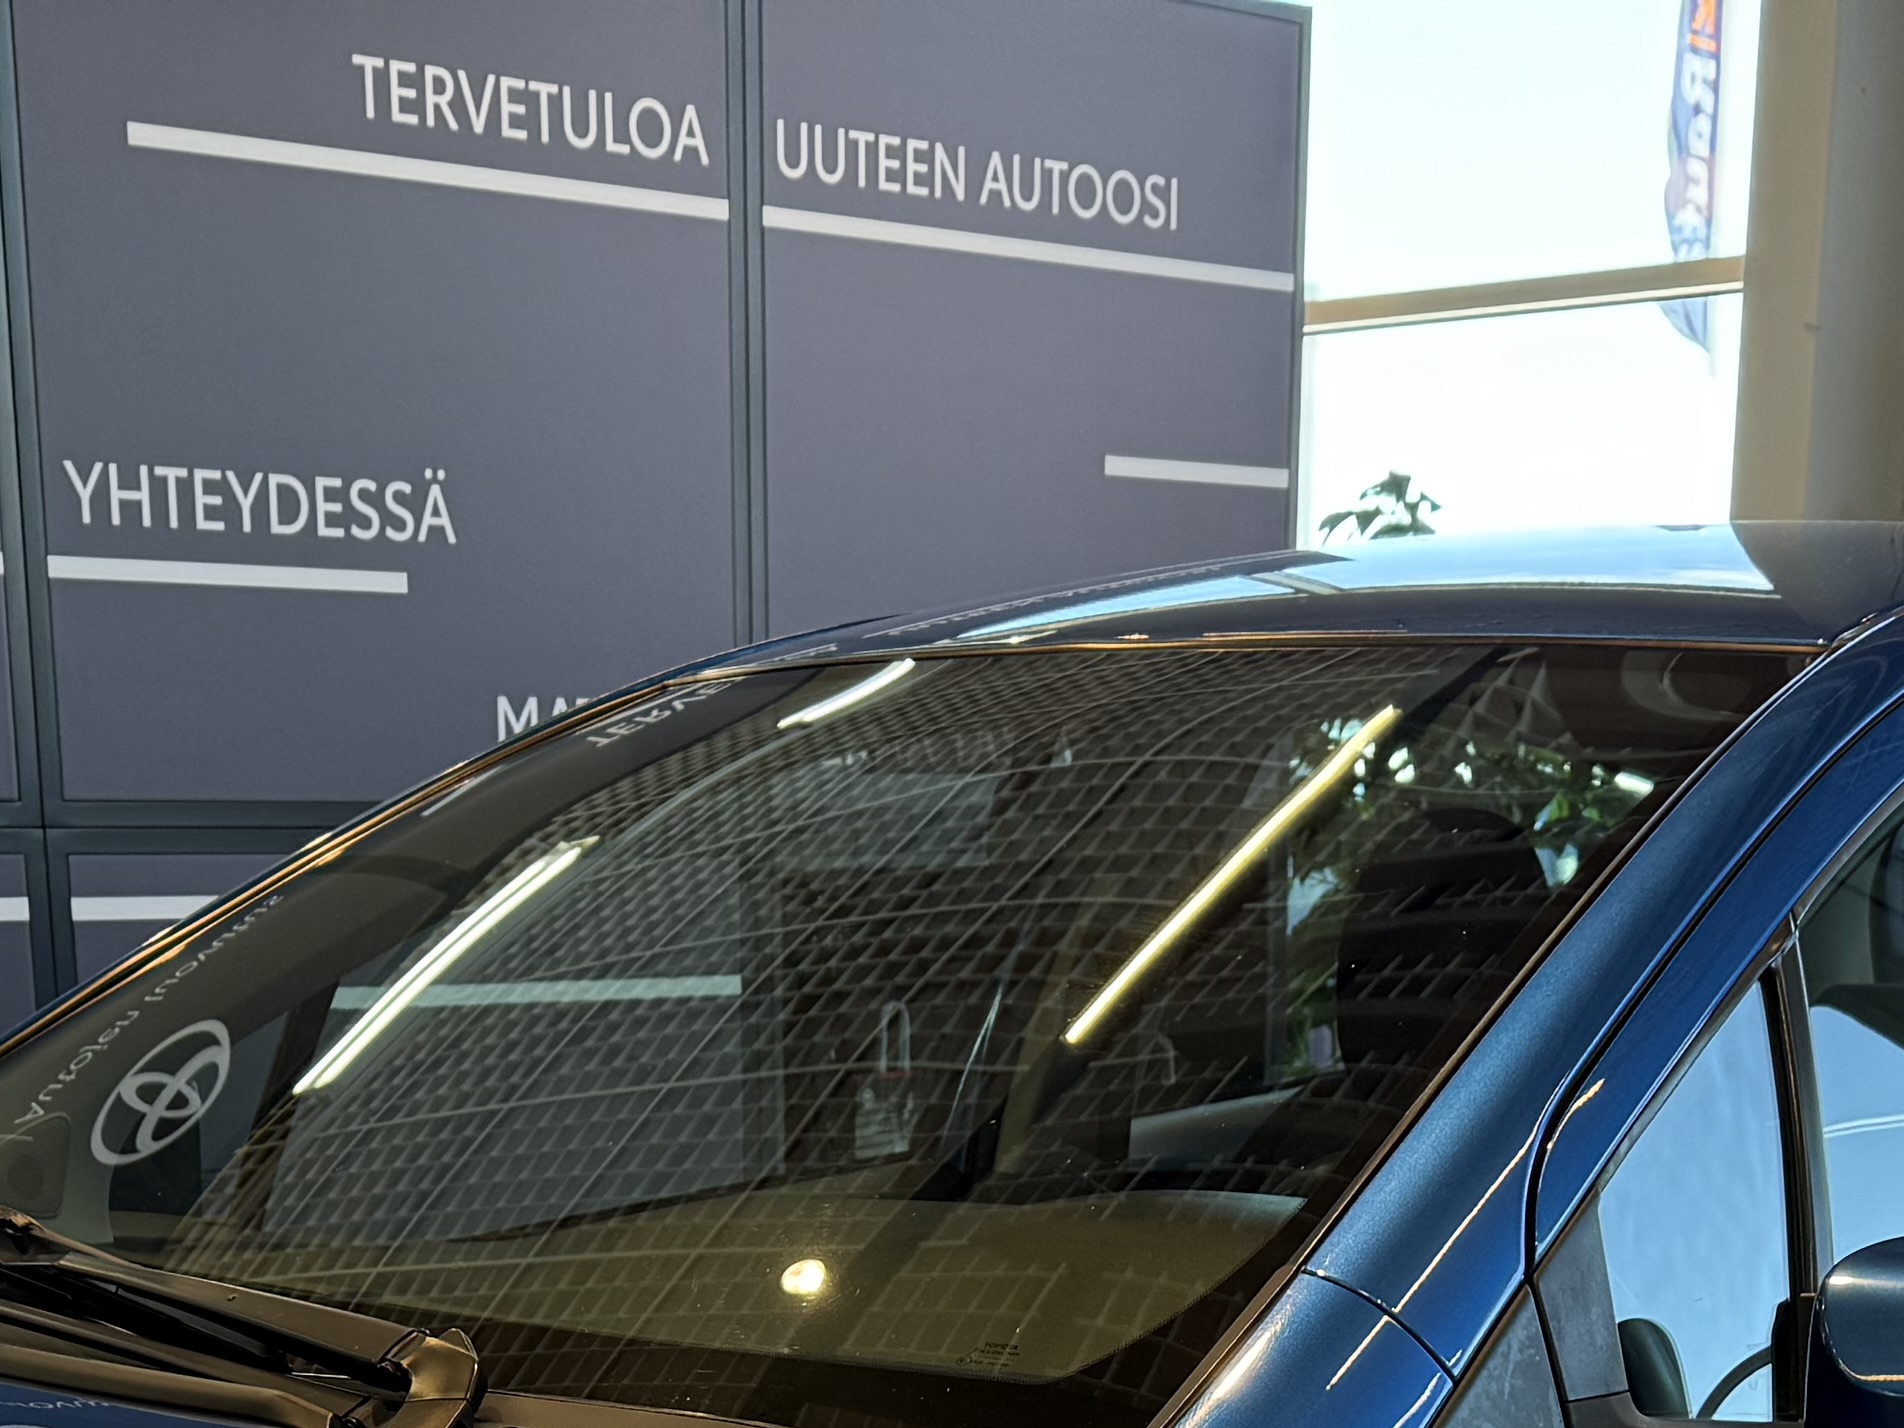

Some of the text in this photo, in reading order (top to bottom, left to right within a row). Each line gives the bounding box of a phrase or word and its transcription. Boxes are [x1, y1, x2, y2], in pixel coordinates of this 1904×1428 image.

[352, 52, 1180, 231] TERVETULOA UUTEEN AUTOOSI
[63, 457, 457, 545] YHTEYDESSÄ
